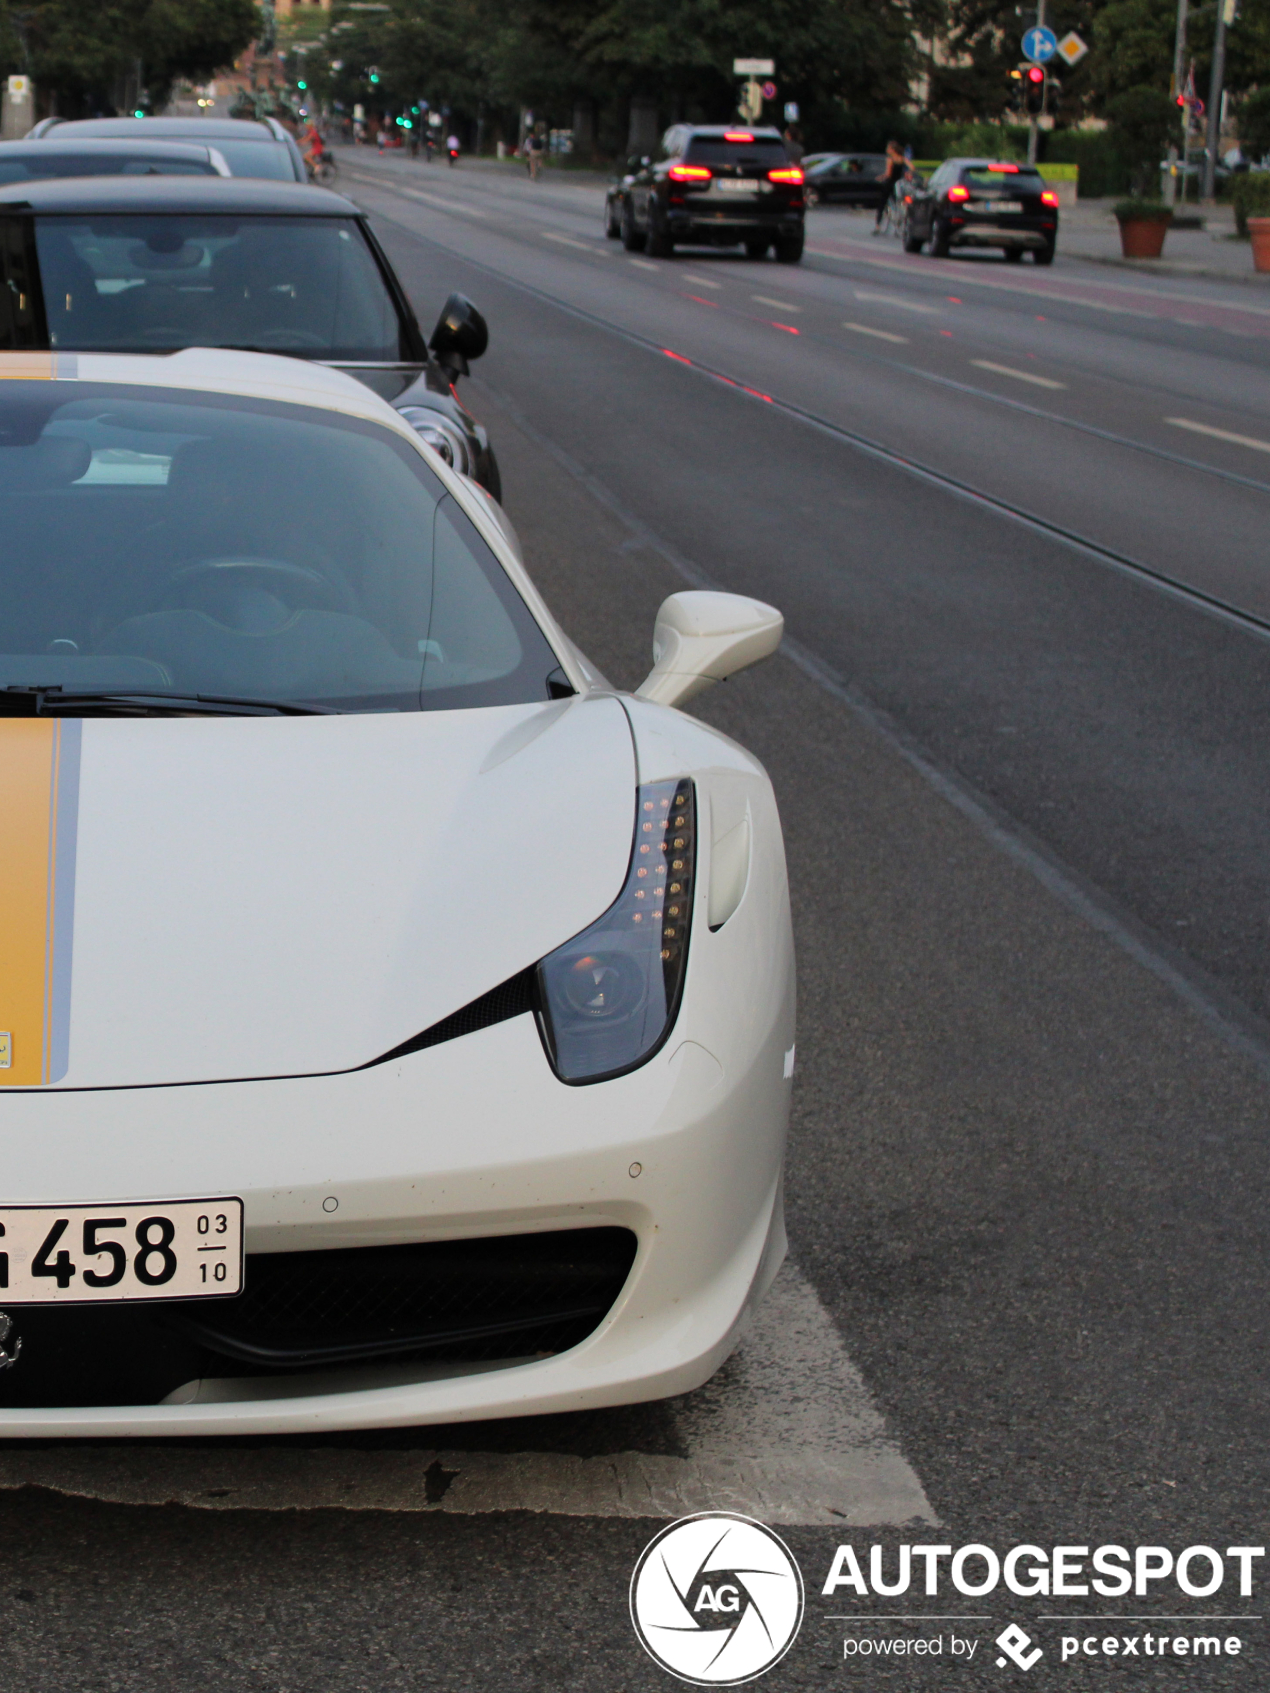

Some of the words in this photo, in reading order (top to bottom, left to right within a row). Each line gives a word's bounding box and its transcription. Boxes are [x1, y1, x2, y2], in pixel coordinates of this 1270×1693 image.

[197, 1213, 228, 1235] 03
[31, 1216, 178, 1289] 458
[199, 1262, 227, 1283] 10
